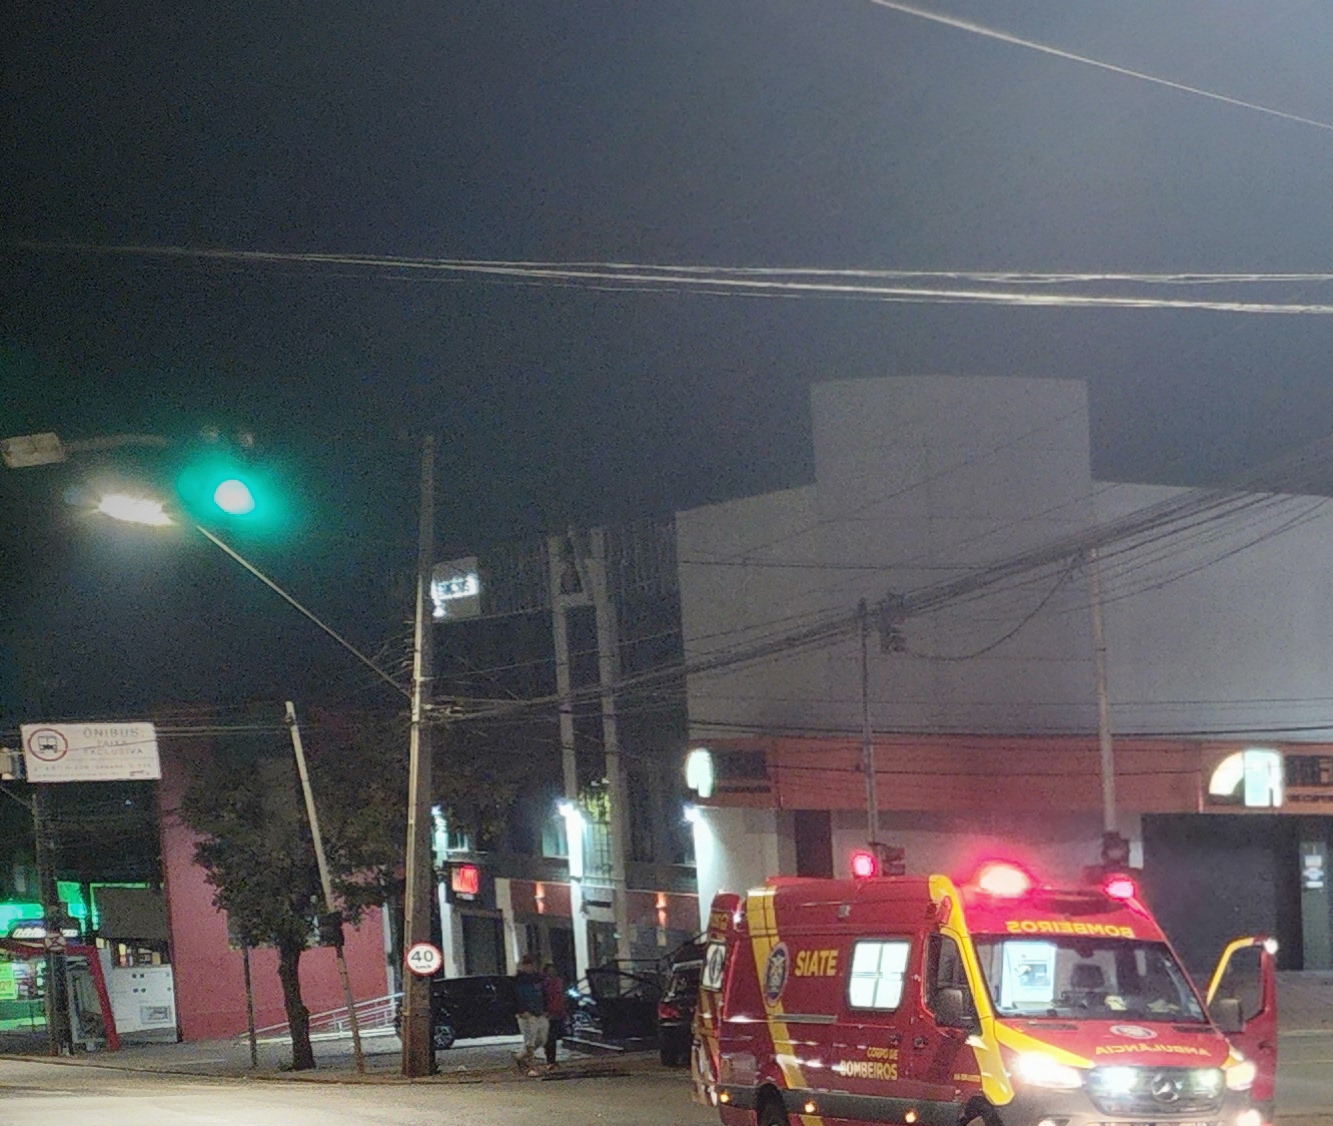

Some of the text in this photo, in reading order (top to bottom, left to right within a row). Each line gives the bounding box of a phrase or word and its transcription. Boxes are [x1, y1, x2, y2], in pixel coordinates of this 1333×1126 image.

[411, 949, 435, 963] 40
[794, 949, 840, 978] SIATE
[839, 1060, 898, 1080] BOMBEIROS
